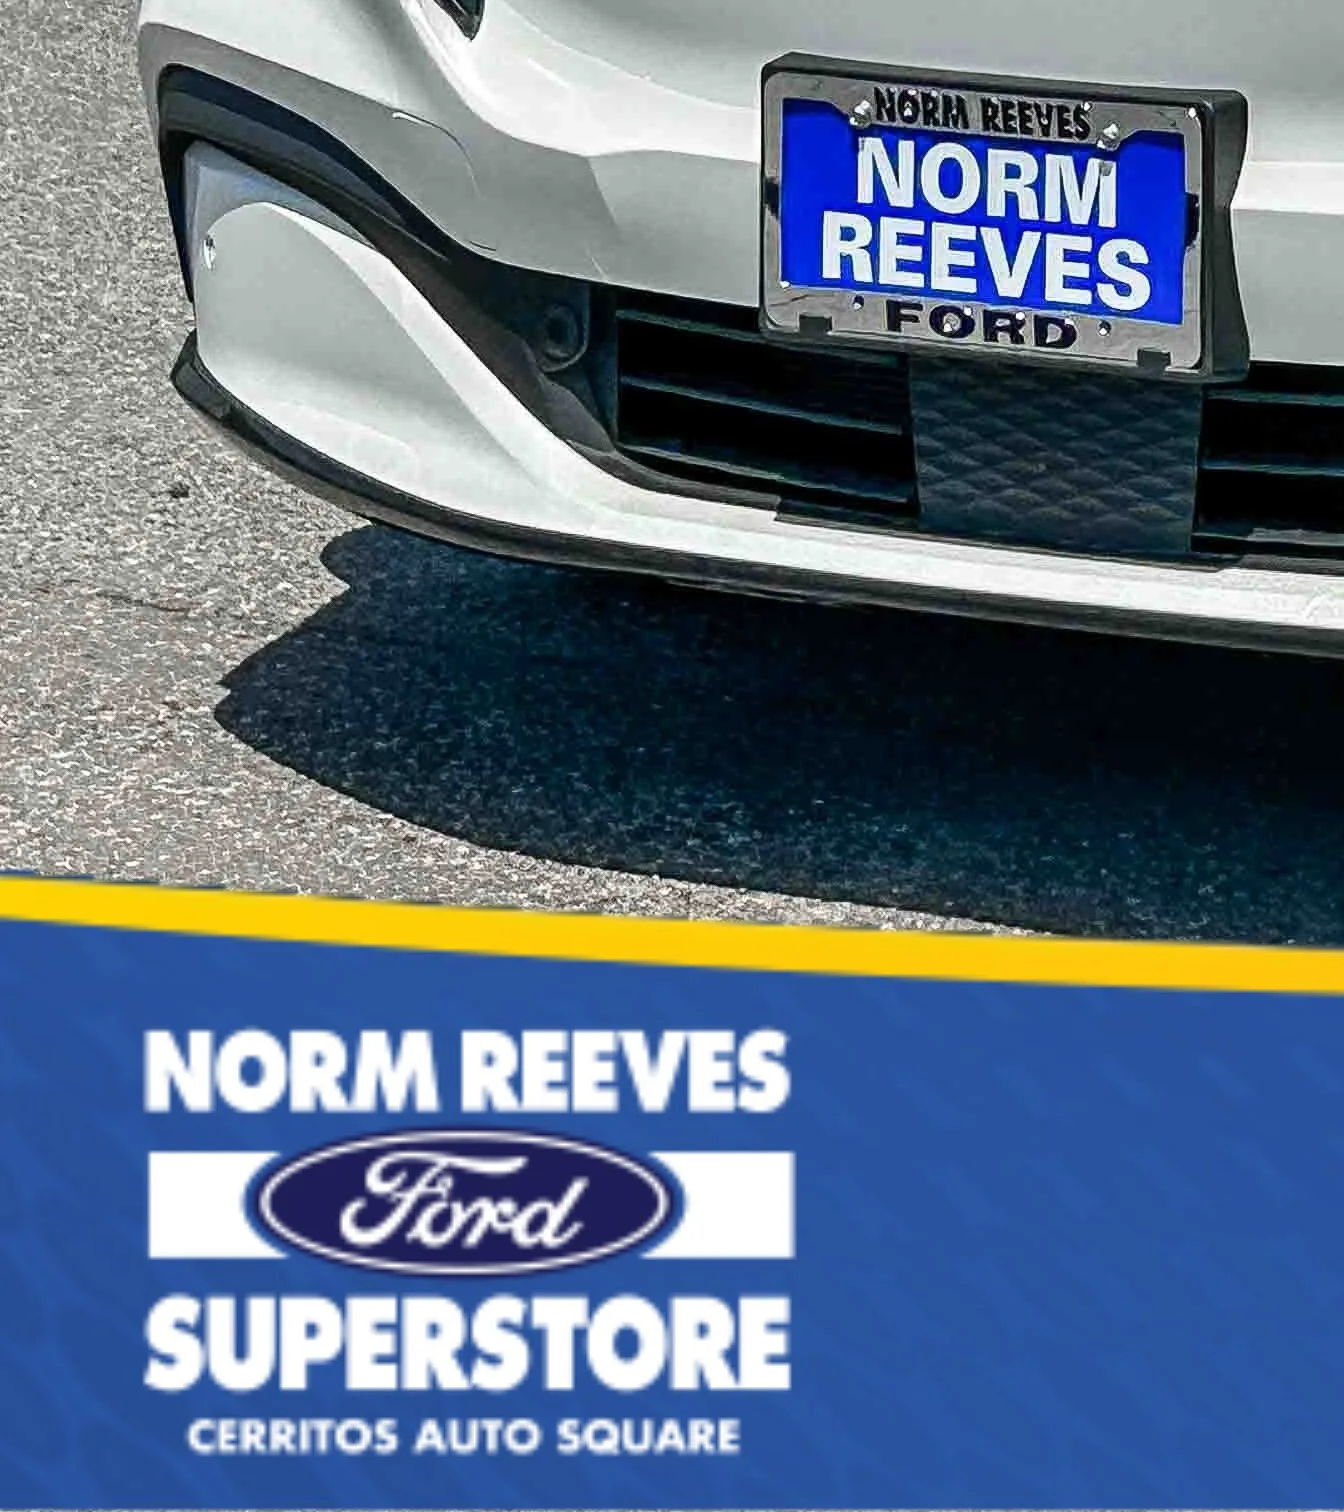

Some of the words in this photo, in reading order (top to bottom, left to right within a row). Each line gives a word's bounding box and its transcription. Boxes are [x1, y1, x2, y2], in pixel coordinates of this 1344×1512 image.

[873, 87, 969, 131] NORM
[980, 96, 1091, 141] REEVES
[856, 136, 1117, 229] NORM
[822, 210, 1151, 312] REEVES
[885, 299, 1078, 349] FORD
